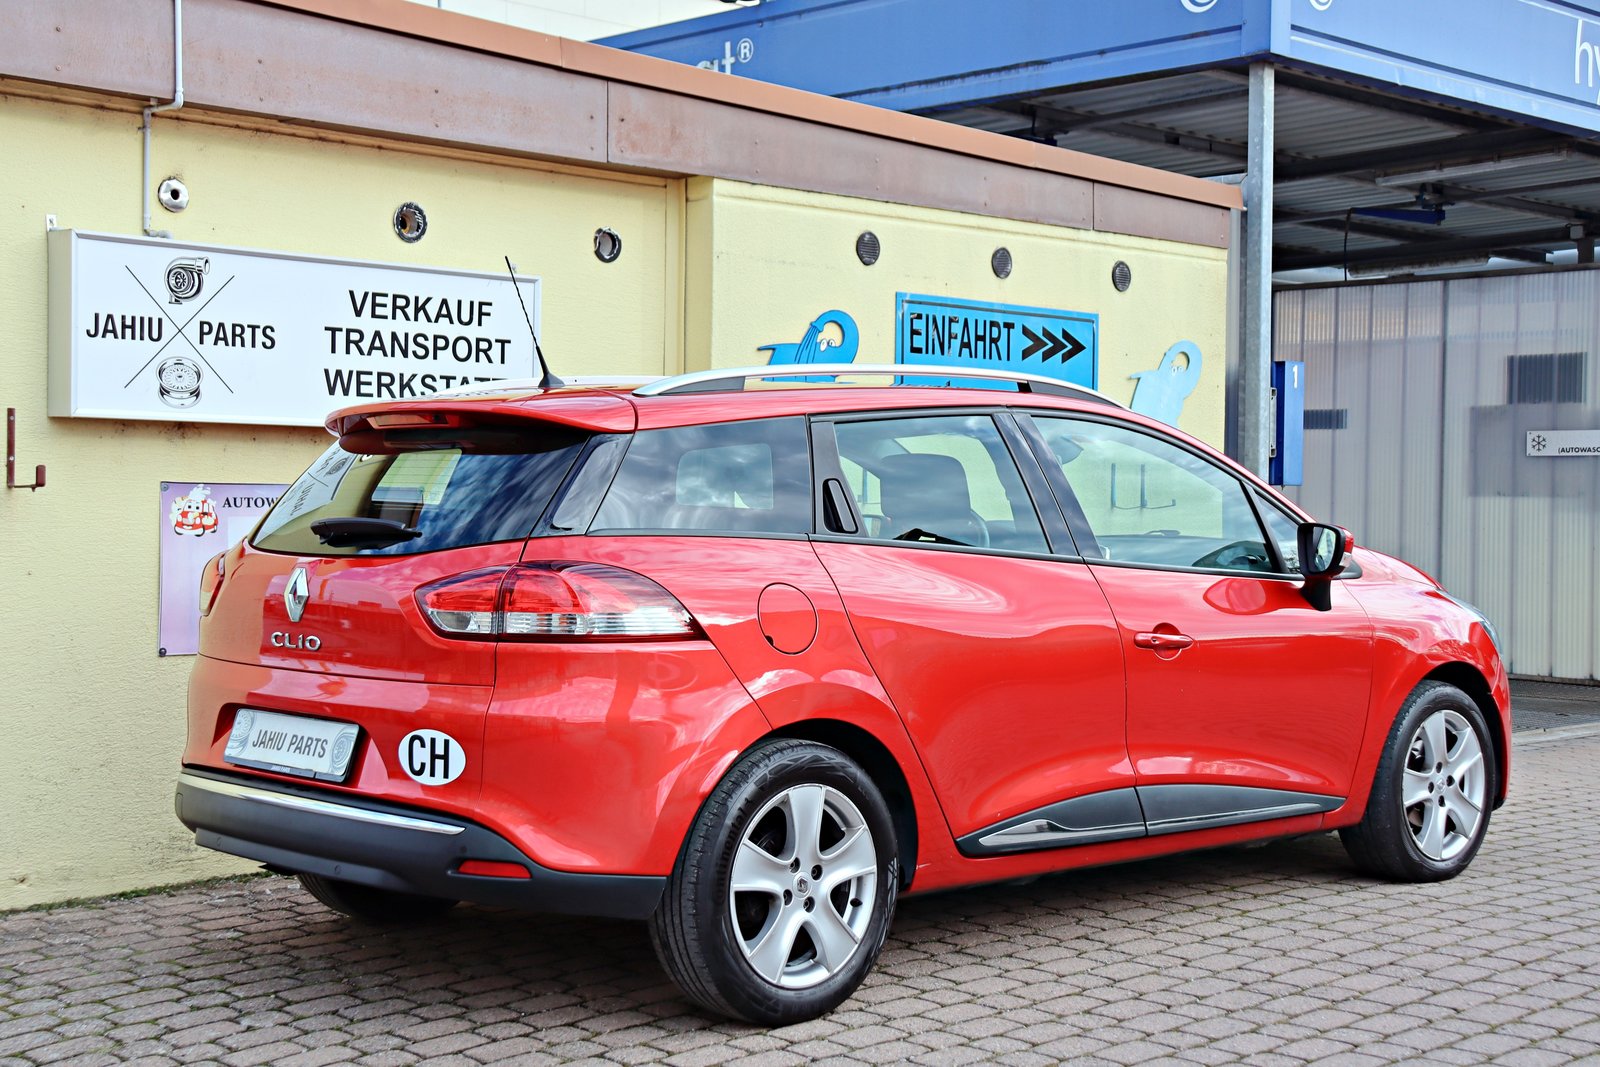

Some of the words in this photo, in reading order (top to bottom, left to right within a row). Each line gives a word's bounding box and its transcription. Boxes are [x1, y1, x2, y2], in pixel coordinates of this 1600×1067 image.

[348, 289, 493, 327] VERKAUF
[86, 312, 163, 342] JAHIU
[199, 320, 276, 350] PARTS
[324, 326, 512, 365] TRANSPORT
[909, 312, 1015, 362] EINFAHRT
[1292, 364, 1299, 389] 1
[252, 729, 288, 752] JAHIU
[286, 734, 329, 758] PARTS
[408, 734, 450, 780] CH
